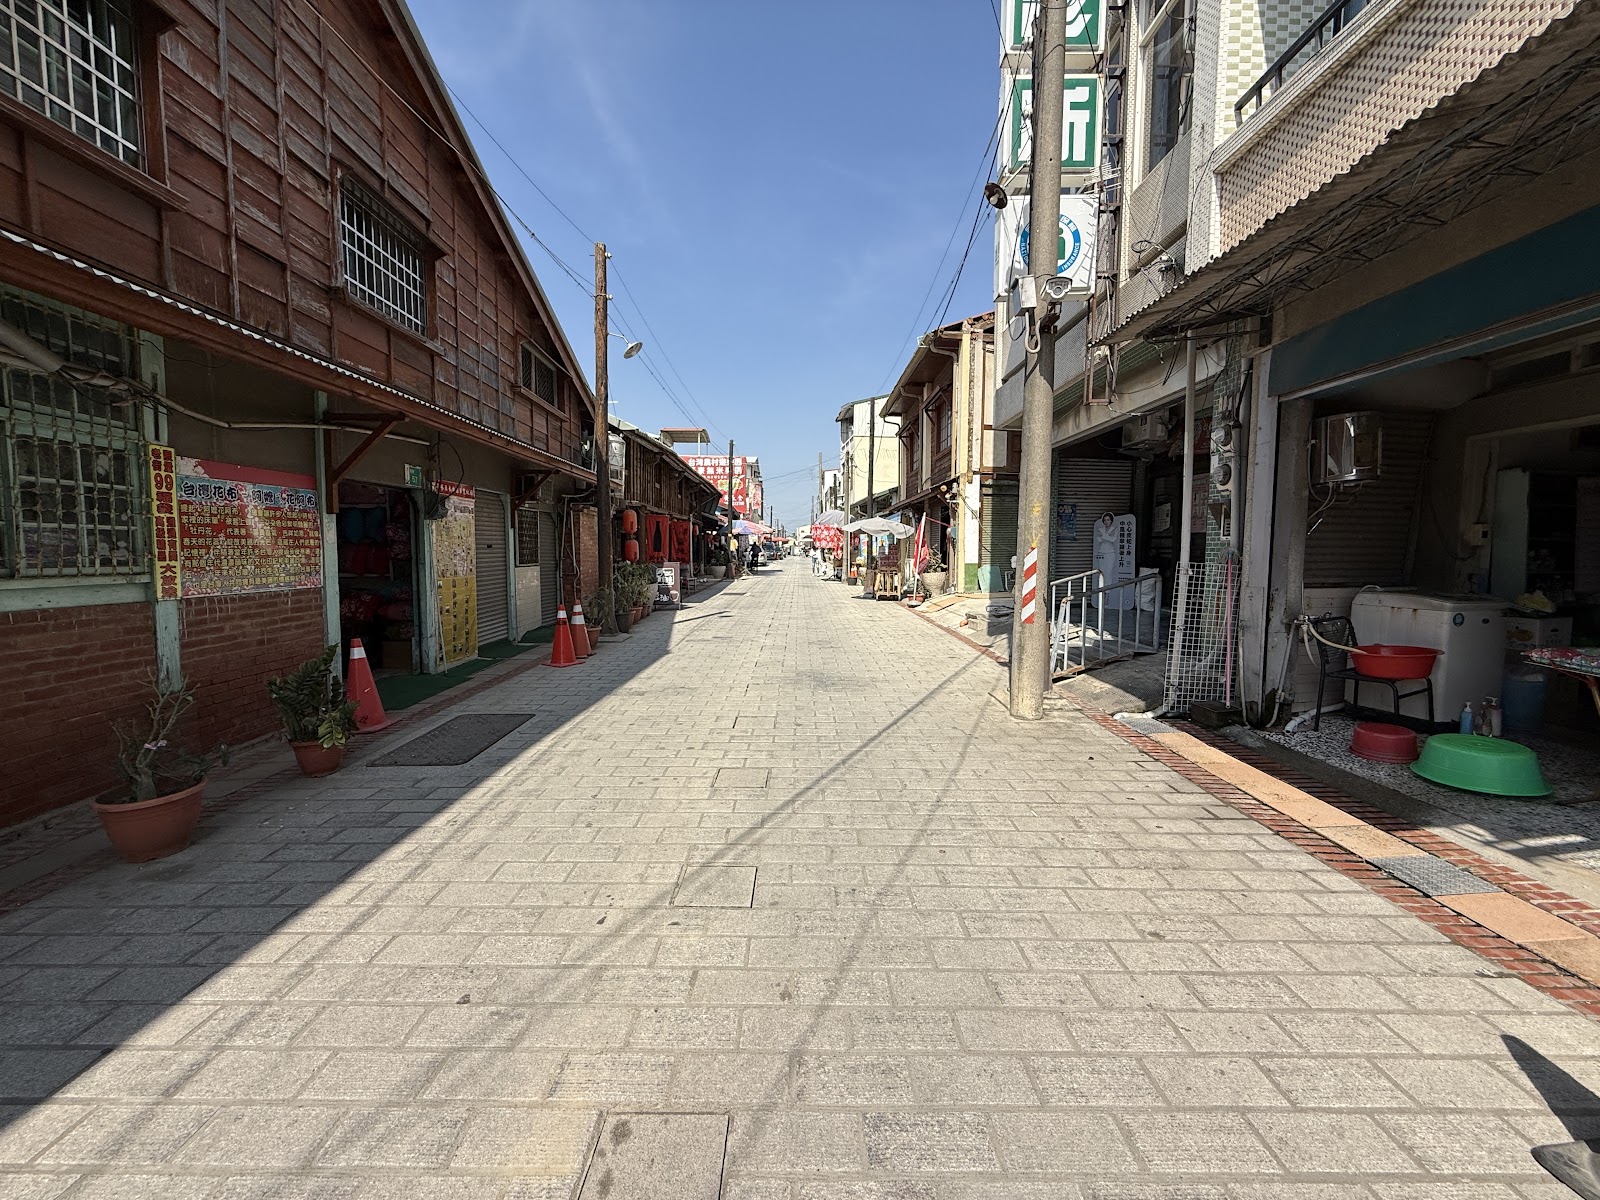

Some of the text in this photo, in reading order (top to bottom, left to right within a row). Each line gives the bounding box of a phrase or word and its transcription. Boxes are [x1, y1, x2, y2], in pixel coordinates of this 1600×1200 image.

[1061, 242, 1080, 270] INSURANCE
[154, 472, 174, 491] 99
[182, 481, 238, 500] 台灣花布
